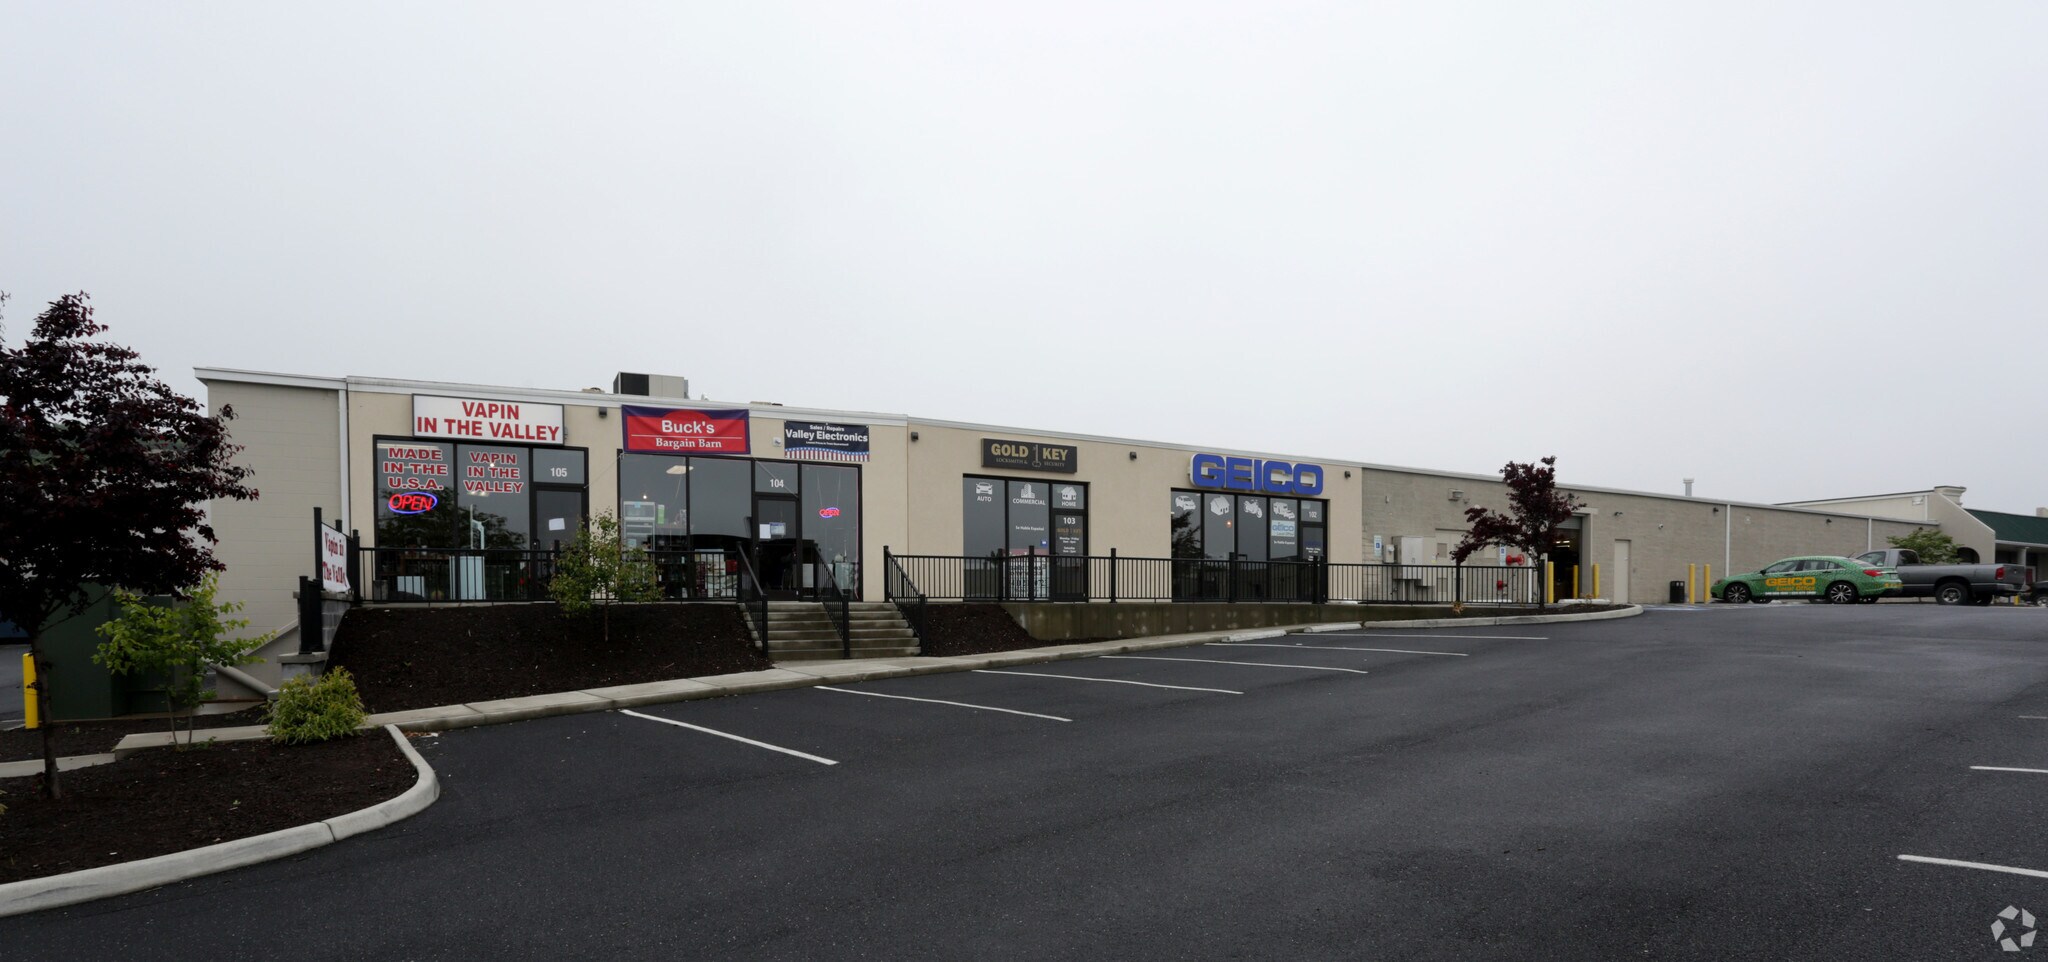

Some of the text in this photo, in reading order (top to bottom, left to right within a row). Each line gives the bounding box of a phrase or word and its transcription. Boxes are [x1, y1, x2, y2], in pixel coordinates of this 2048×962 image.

[462, 401, 520, 420] VAPIN
[417, 416, 560, 442] IN THE VALLEY
[661, 419, 715, 434] Buck's
[785, 428, 868, 442] Valley Electronics
[655, 437, 723, 450] Bargain Barn
[388, 447, 443, 461] MADE
[469, 451, 517, 465] VAPIN
[991, 443, 1069, 461] GOLD KEY
[383, 462, 449, 476] IN THE
[467, 466, 520, 480] IN THE
[550, 467, 568, 479] 105
[1190, 453, 1324, 496] GEICO
[388, 477, 444, 491] U.S.A.
[463, 480, 524, 493] VALLEY
[769, 478, 784, 489] 104
[389, 493, 433, 511] OPEN
[976, 495, 992, 503] AUTO
[1012, 498, 1046, 506] COMMERCIAL
[1063, 517, 1076, 525] 103
[1765, 576, 1817, 587] GEICO
